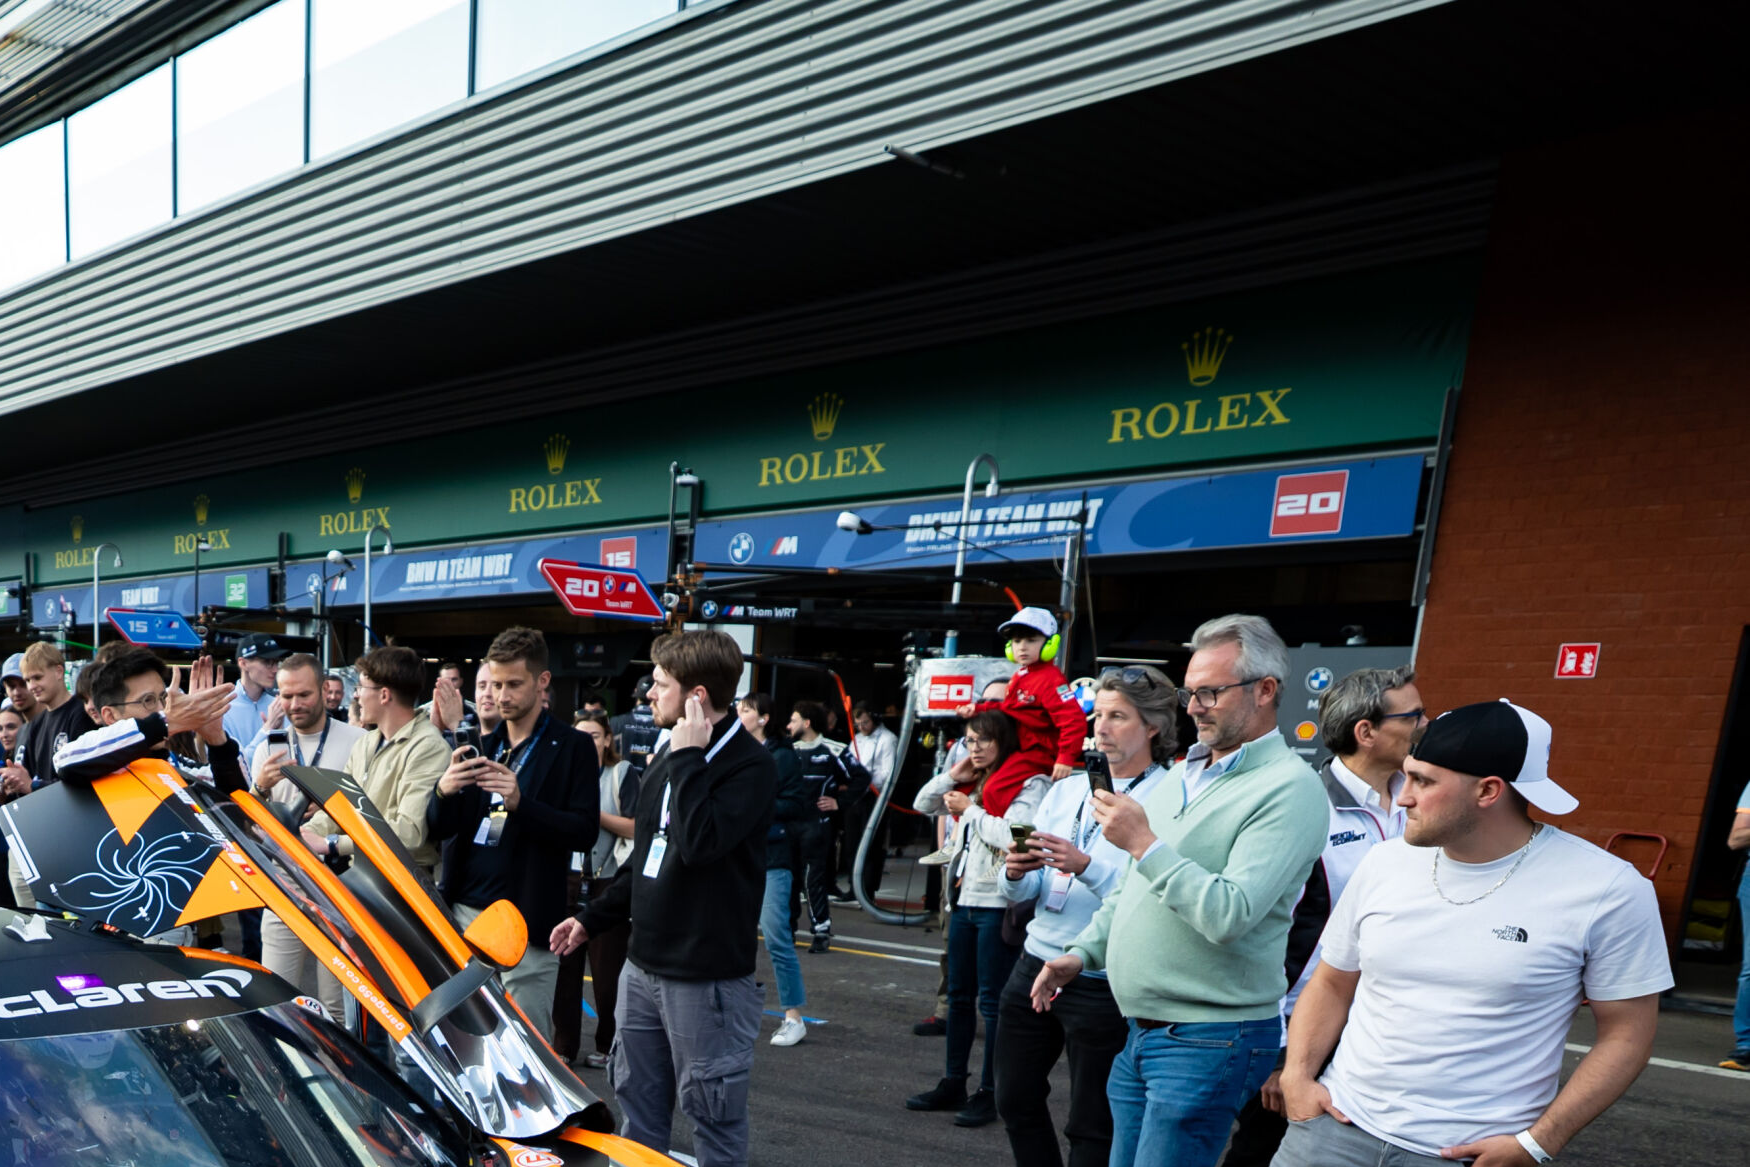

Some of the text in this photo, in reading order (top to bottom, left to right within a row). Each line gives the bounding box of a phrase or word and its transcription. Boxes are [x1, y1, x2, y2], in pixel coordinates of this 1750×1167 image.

[1108, 387, 1292, 445] ROLEX
[758, 443, 886, 486] ROLEX
[509, 478, 602, 512] ROLEX
[1277, 491, 1339, 517] 20
[320, 506, 391, 535] ROLEX
[983, 503, 1046, 537] TEAM
[450, 556, 482, 580] TEAM
[605, 551, 631, 568] 15
[565, 577, 599, 598] 20
[747, 606, 773, 617] Team
[774, 607, 798, 619] WRT
[128, 620, 148, 633] 15
[929, 684, 972, 702] 20
